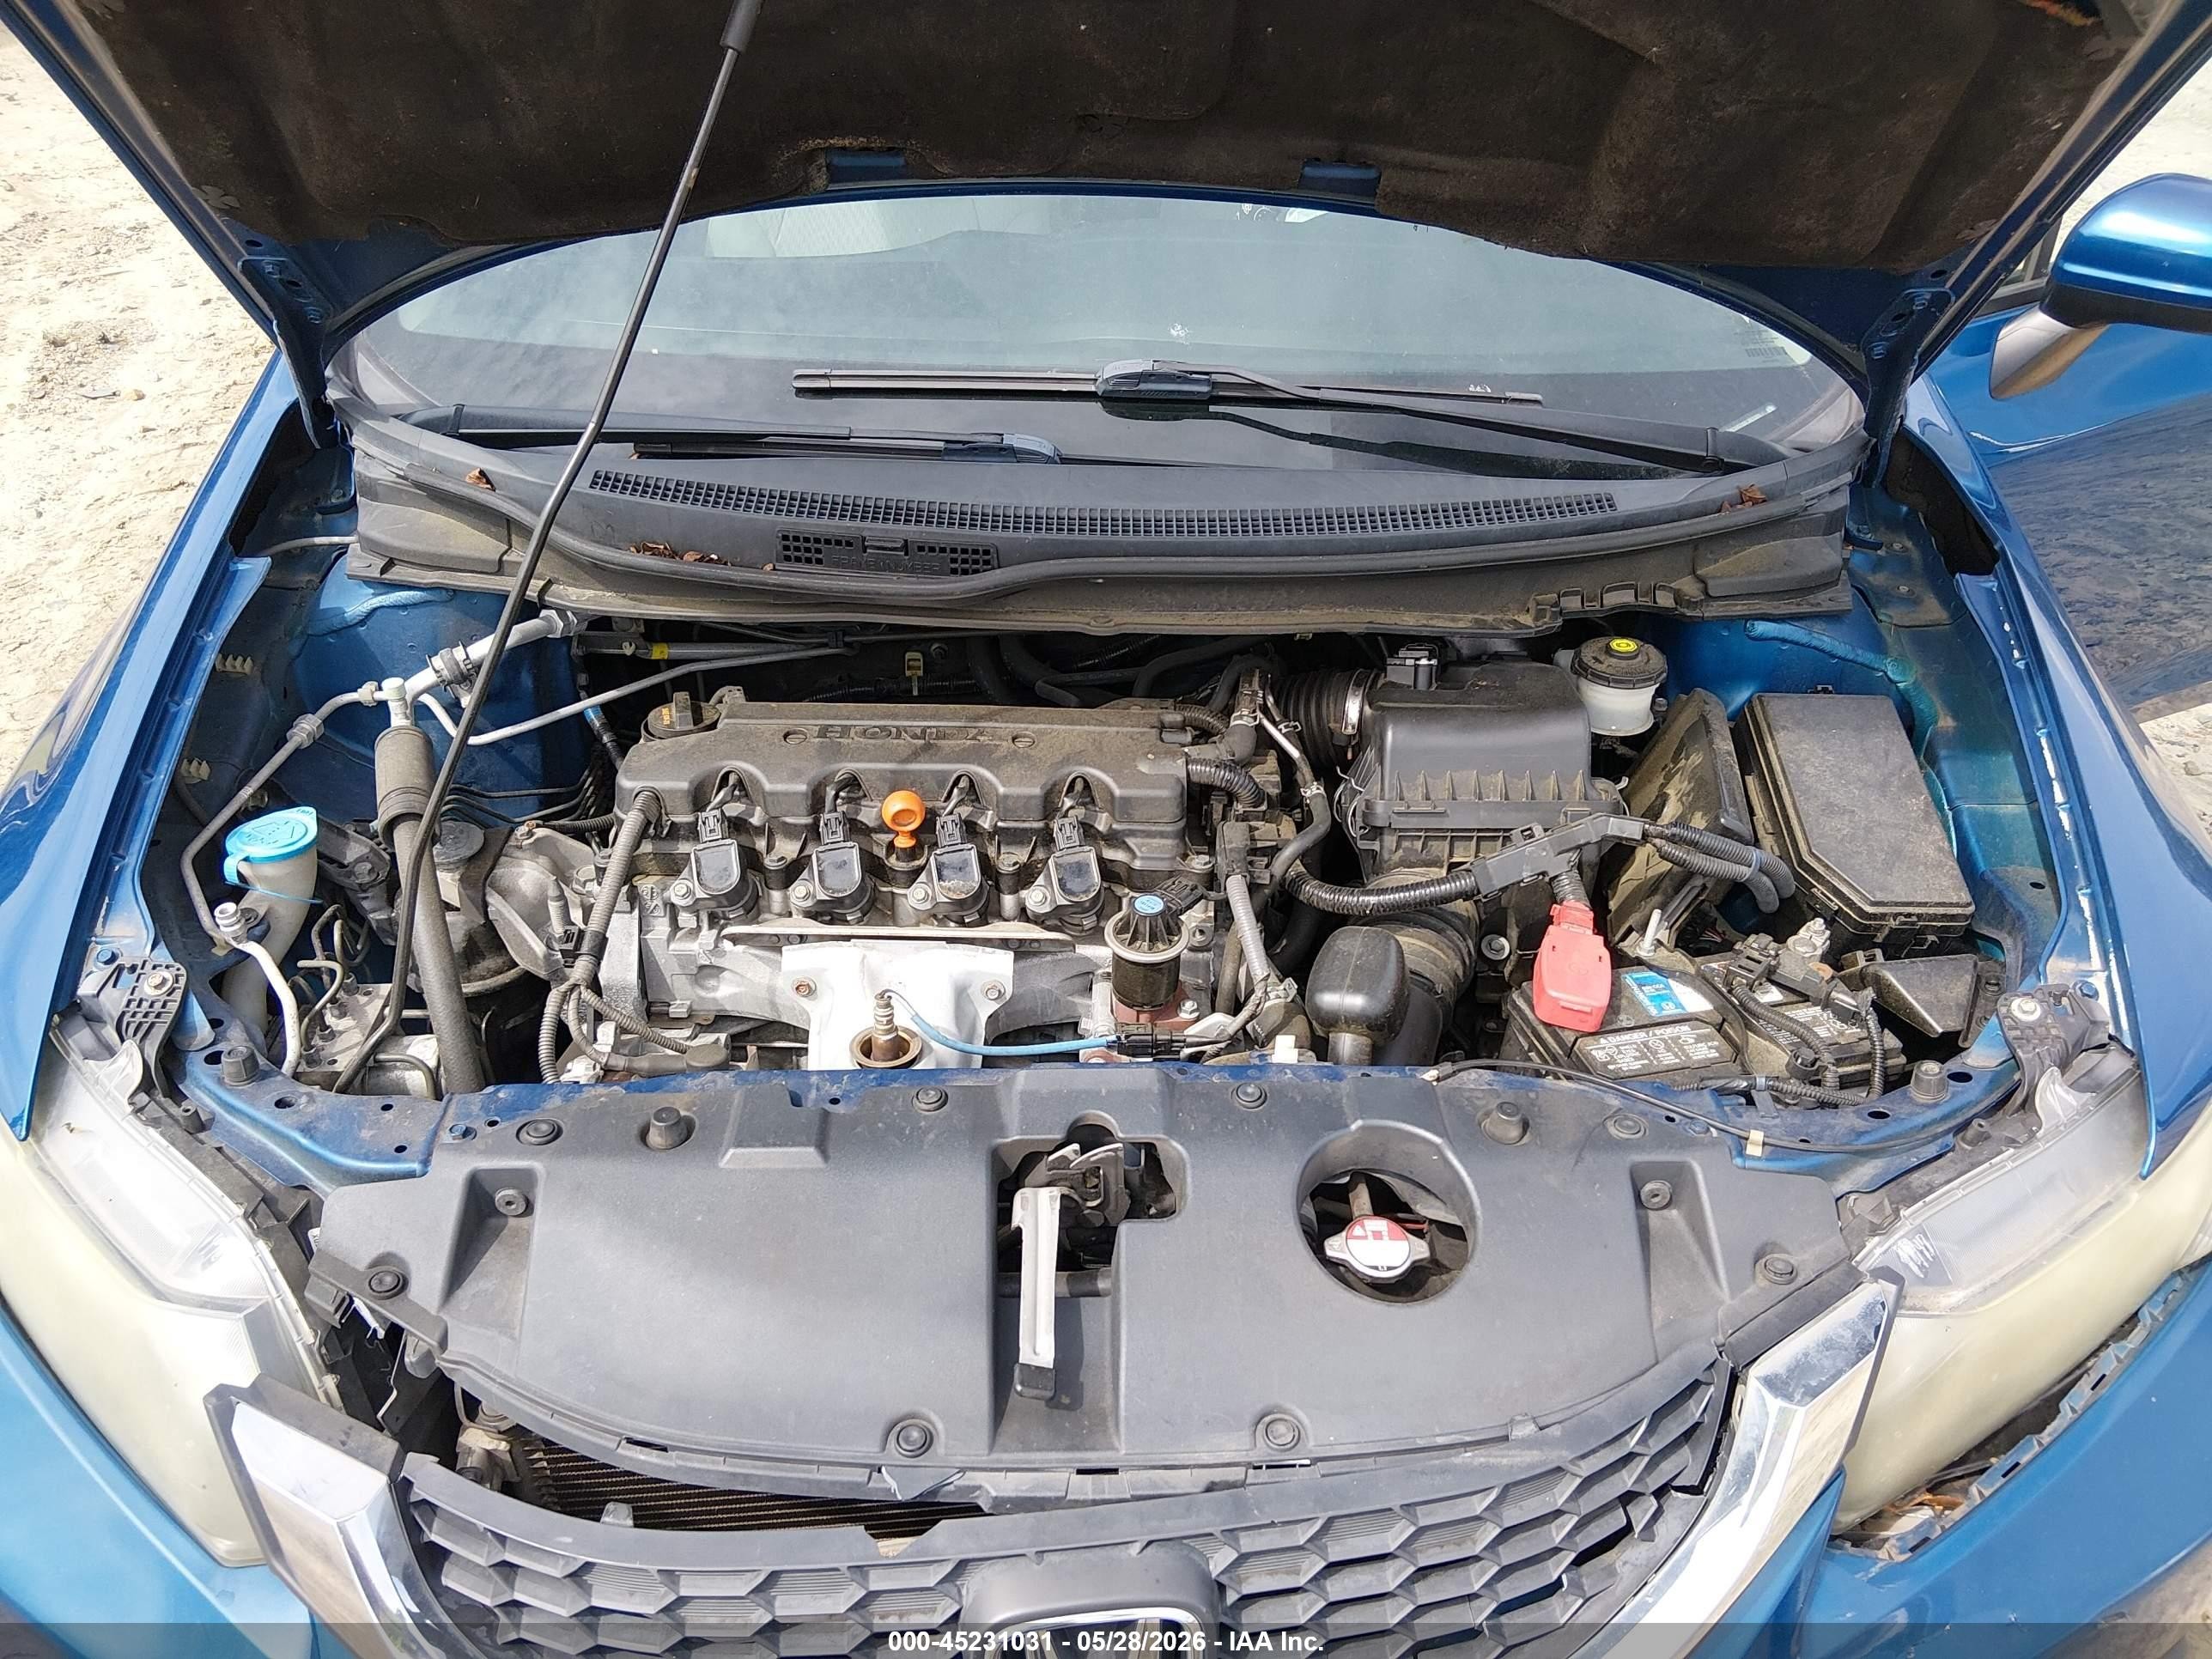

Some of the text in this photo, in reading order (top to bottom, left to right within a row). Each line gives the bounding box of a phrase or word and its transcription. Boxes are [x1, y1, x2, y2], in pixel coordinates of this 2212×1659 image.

[830, 555, 942, 574] FRAME NUMBER
[813, 726, 1007, 742] HONDA
[1607, 1031, 1649, 1043] DANGER
[1655, 1025, 1692, 1036] POISON
